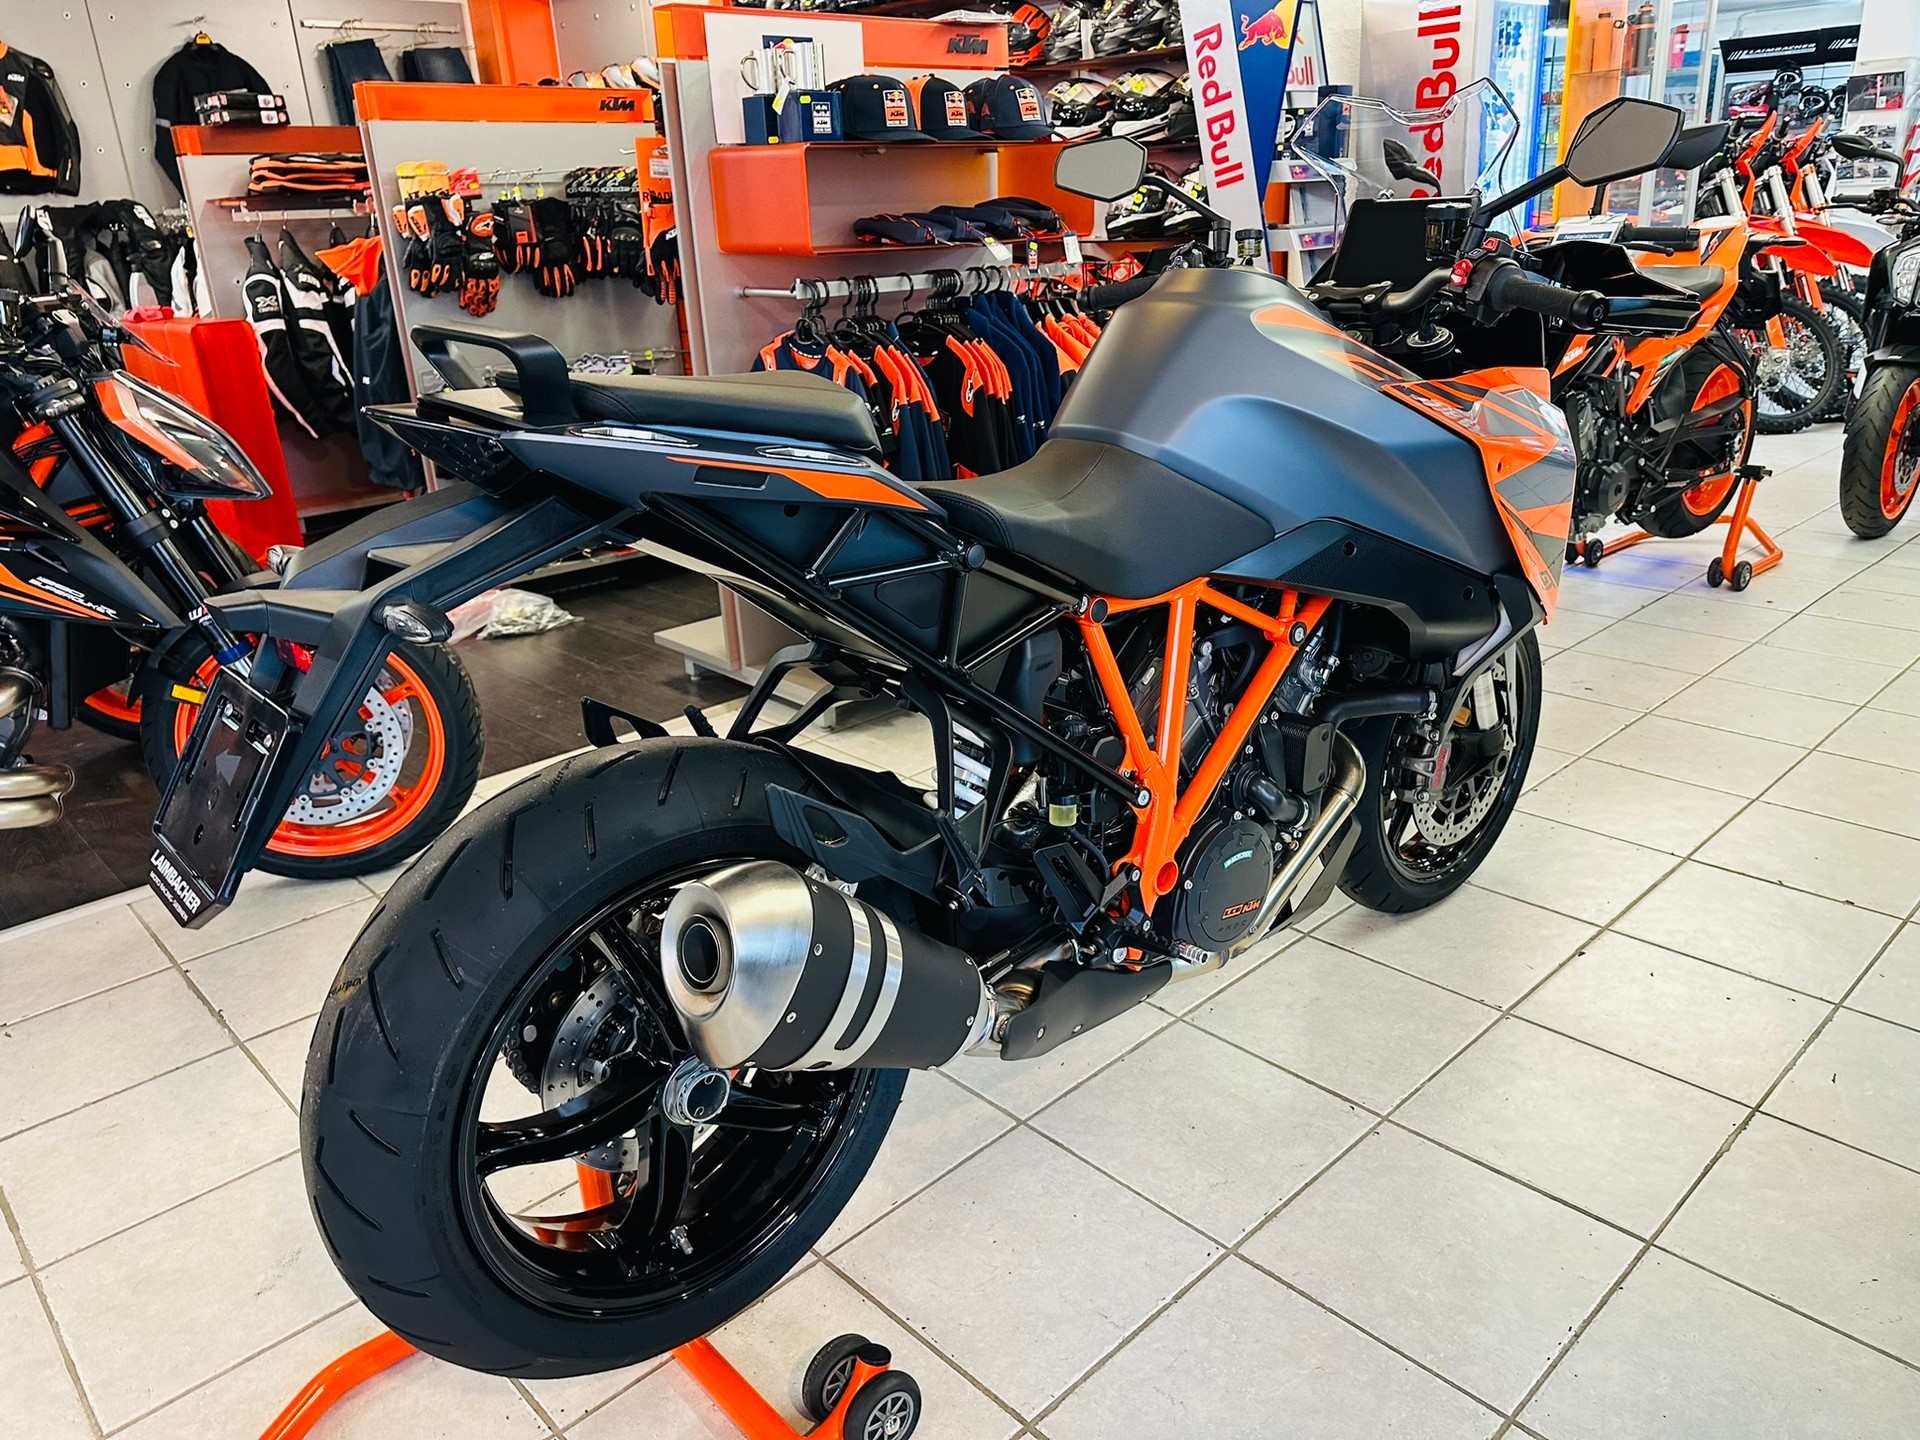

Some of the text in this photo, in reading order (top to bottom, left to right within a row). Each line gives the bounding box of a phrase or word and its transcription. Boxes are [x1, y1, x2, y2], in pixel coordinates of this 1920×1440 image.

[947, 33, 988, 54] KTM
[599, 96, 635, 111] KTM
[1193, 22, 1245, 189] Red Bull
[150, 848, 202, 914] LAIMBACHER
